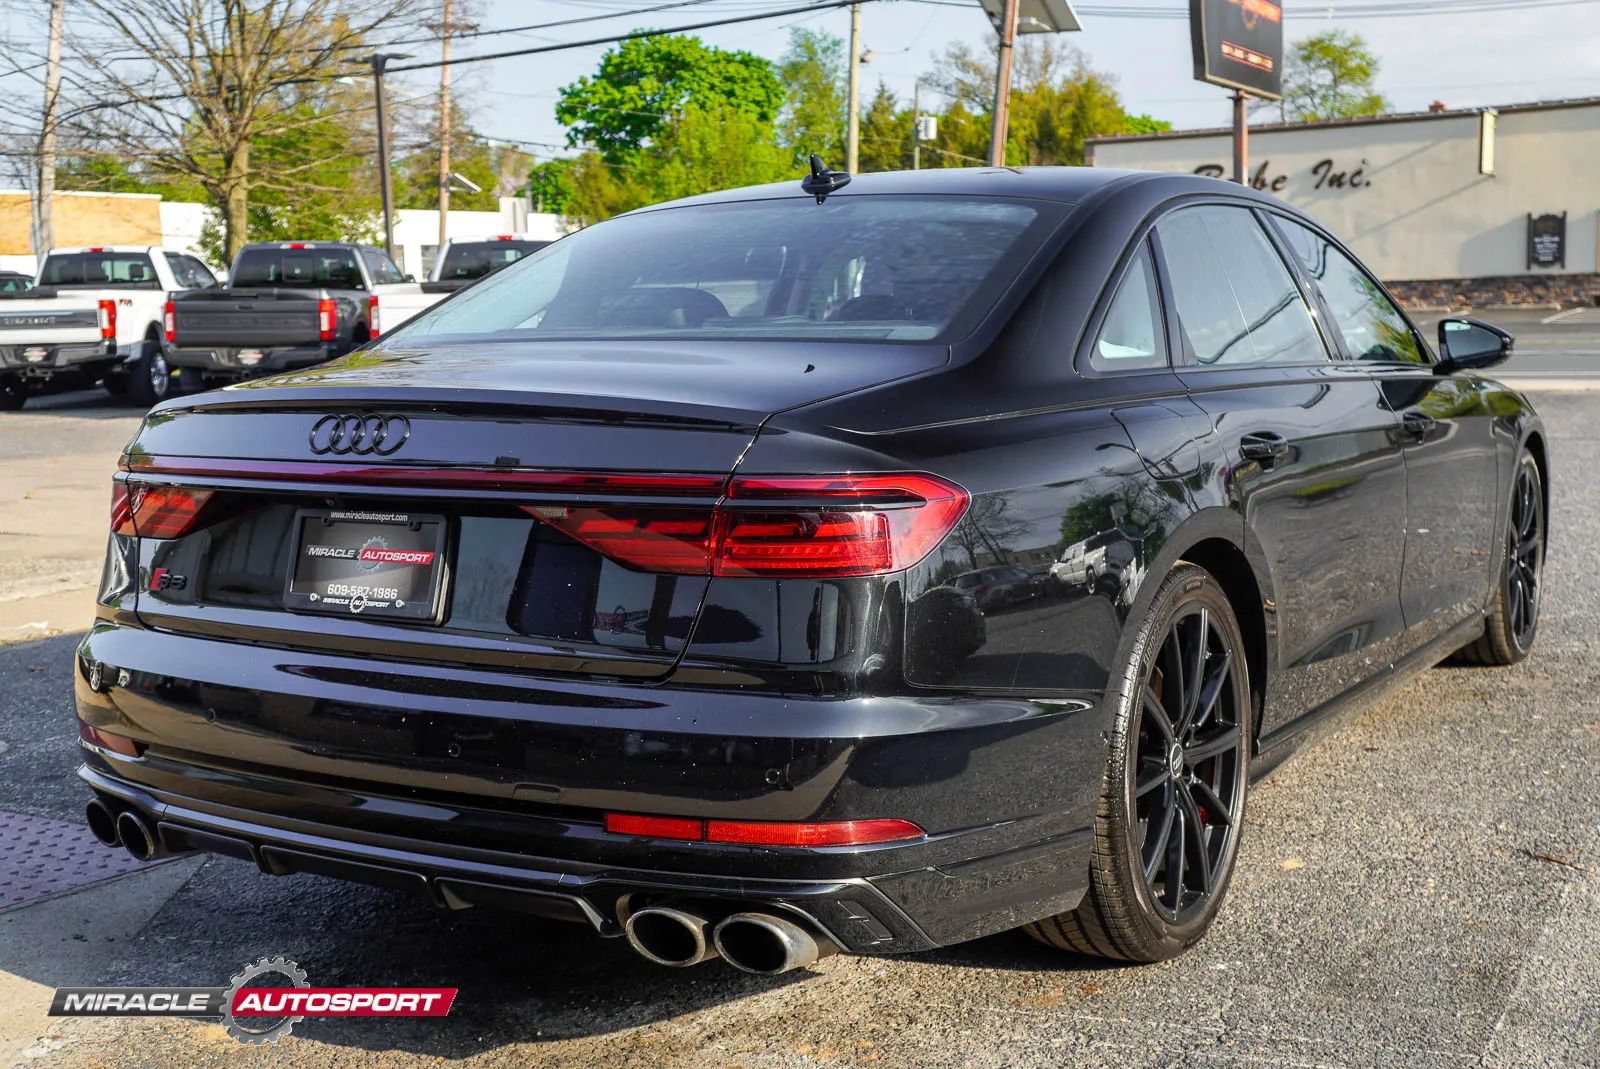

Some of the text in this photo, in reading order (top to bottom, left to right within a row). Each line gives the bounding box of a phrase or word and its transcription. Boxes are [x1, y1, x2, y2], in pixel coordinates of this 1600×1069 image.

[1312, 157, 1372, 190] Inc.
[330, 511, 408, 523] www.miracleautosport.com
[308, 547, 430, 563] MIRACLE AUTOSPORT
[327, 584, 399, 600] 609-587-1986
[322, 597, 391, 609] MIRACLE AUTOSPORT
